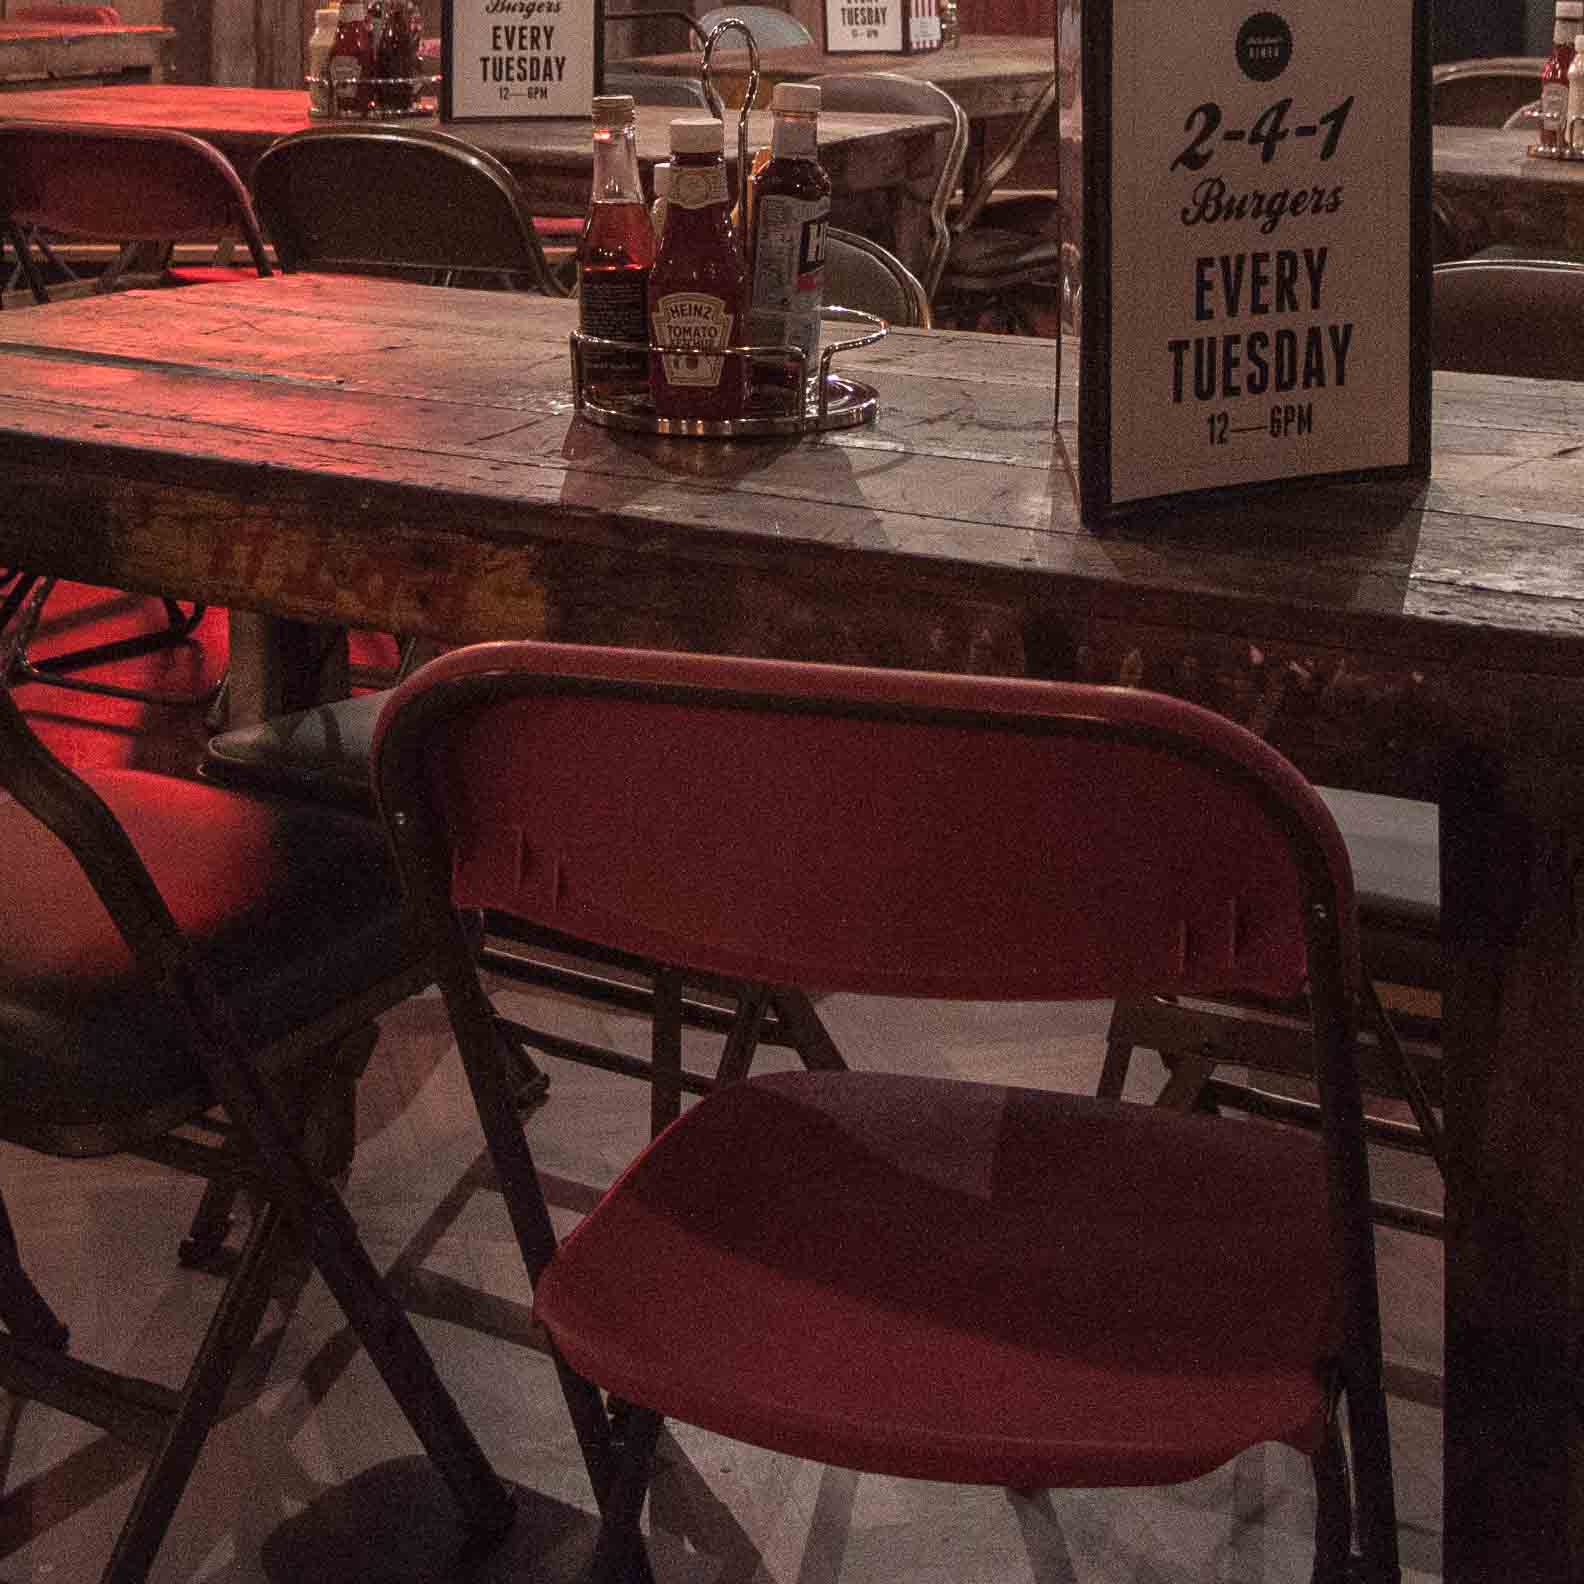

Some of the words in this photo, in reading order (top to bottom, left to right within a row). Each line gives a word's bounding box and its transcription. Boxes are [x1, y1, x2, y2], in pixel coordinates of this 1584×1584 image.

[841, 7, 888, 27] TUESDAY
[492, 25, 555, 51] EVERY
[480, 56, 567, 83] TUESDAY
[1170, 96, 1355, 173] 2-4-1
[1181, 177, 1345, 234] Burgers
[1194, 247, 1329, 322] EVERY
[670, 303, 713, 320] HEINZ
[666, 325, 718, 338] TOMATO
[1167, 324, 1353, 404] TUESDAY
